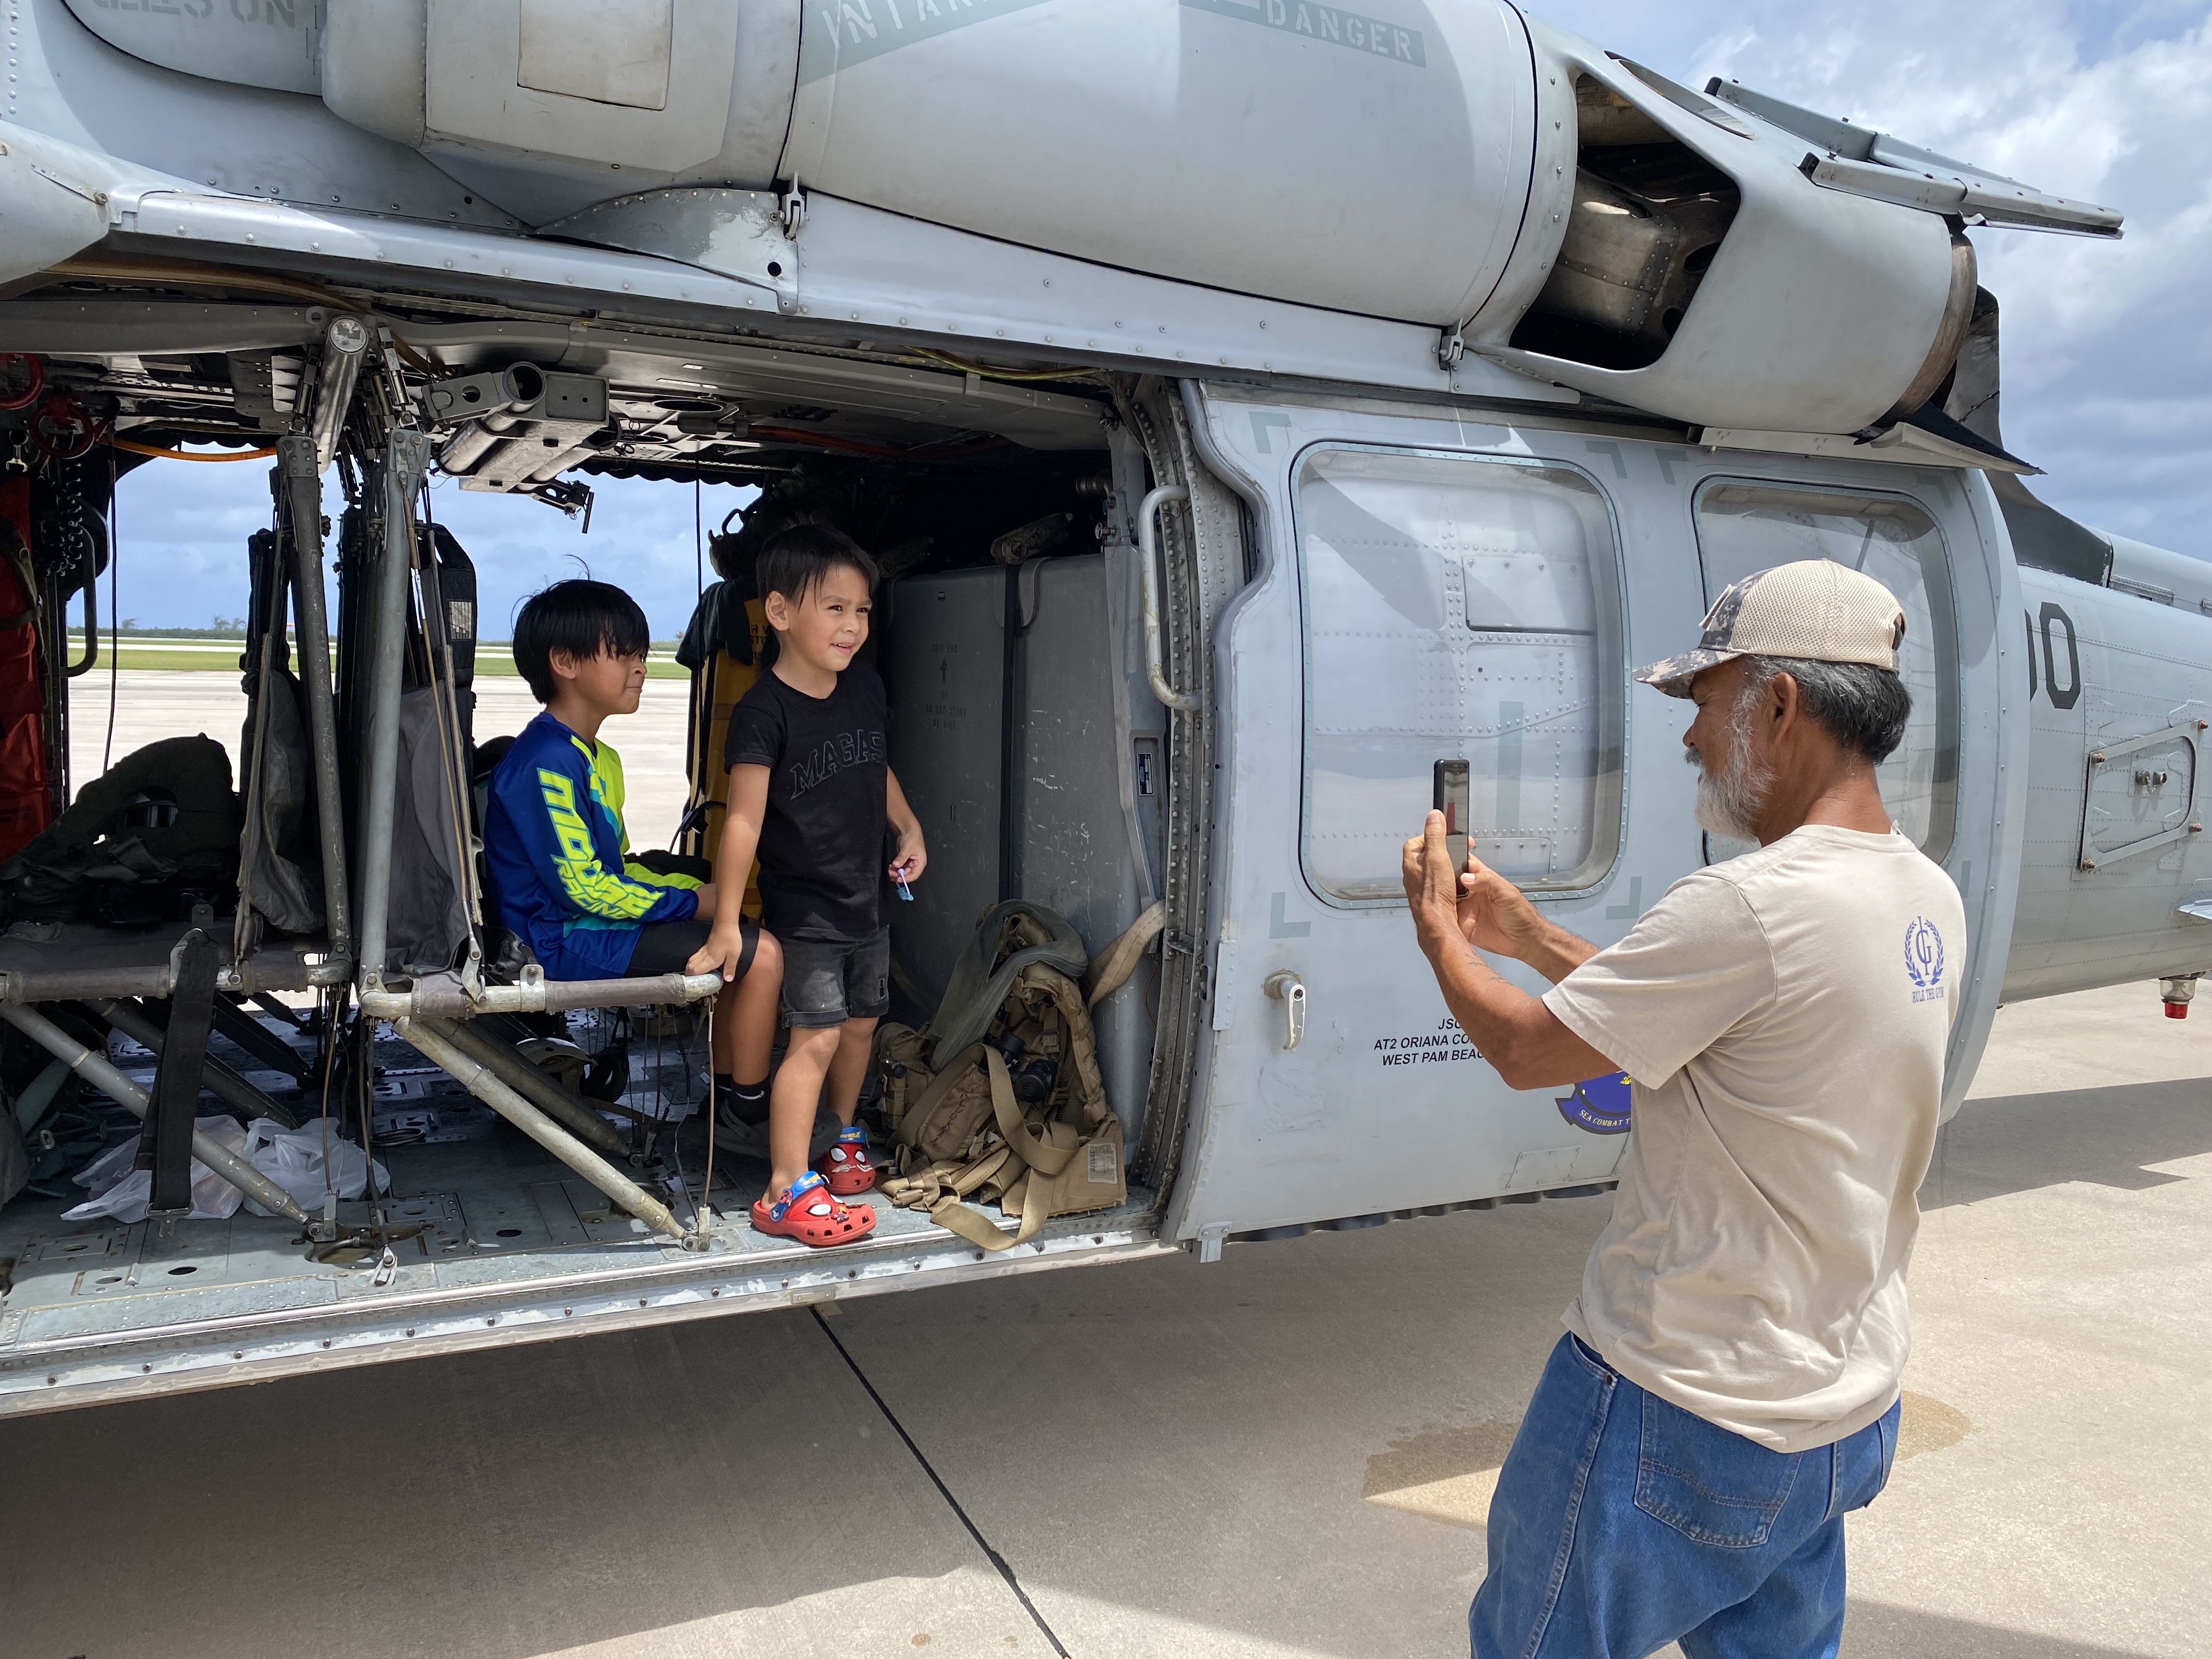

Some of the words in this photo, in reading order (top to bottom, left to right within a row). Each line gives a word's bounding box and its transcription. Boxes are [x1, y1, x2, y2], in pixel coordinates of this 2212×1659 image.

[1267, 0, 1412, 60] DANGER
[1374, 1039, 1397, 1051] AT2
[1401, 1035, 1449, 1048] ORIANA
[1452, 1034, 1474, 1045] CO
[1383, 1053, 1419, 1066] WEST
[1421, 1051, 1448, 1063] PAM
[1579, 1109, 1592, 1122] SEA
[1593, 1118, 1624, 1127] COMBAT
